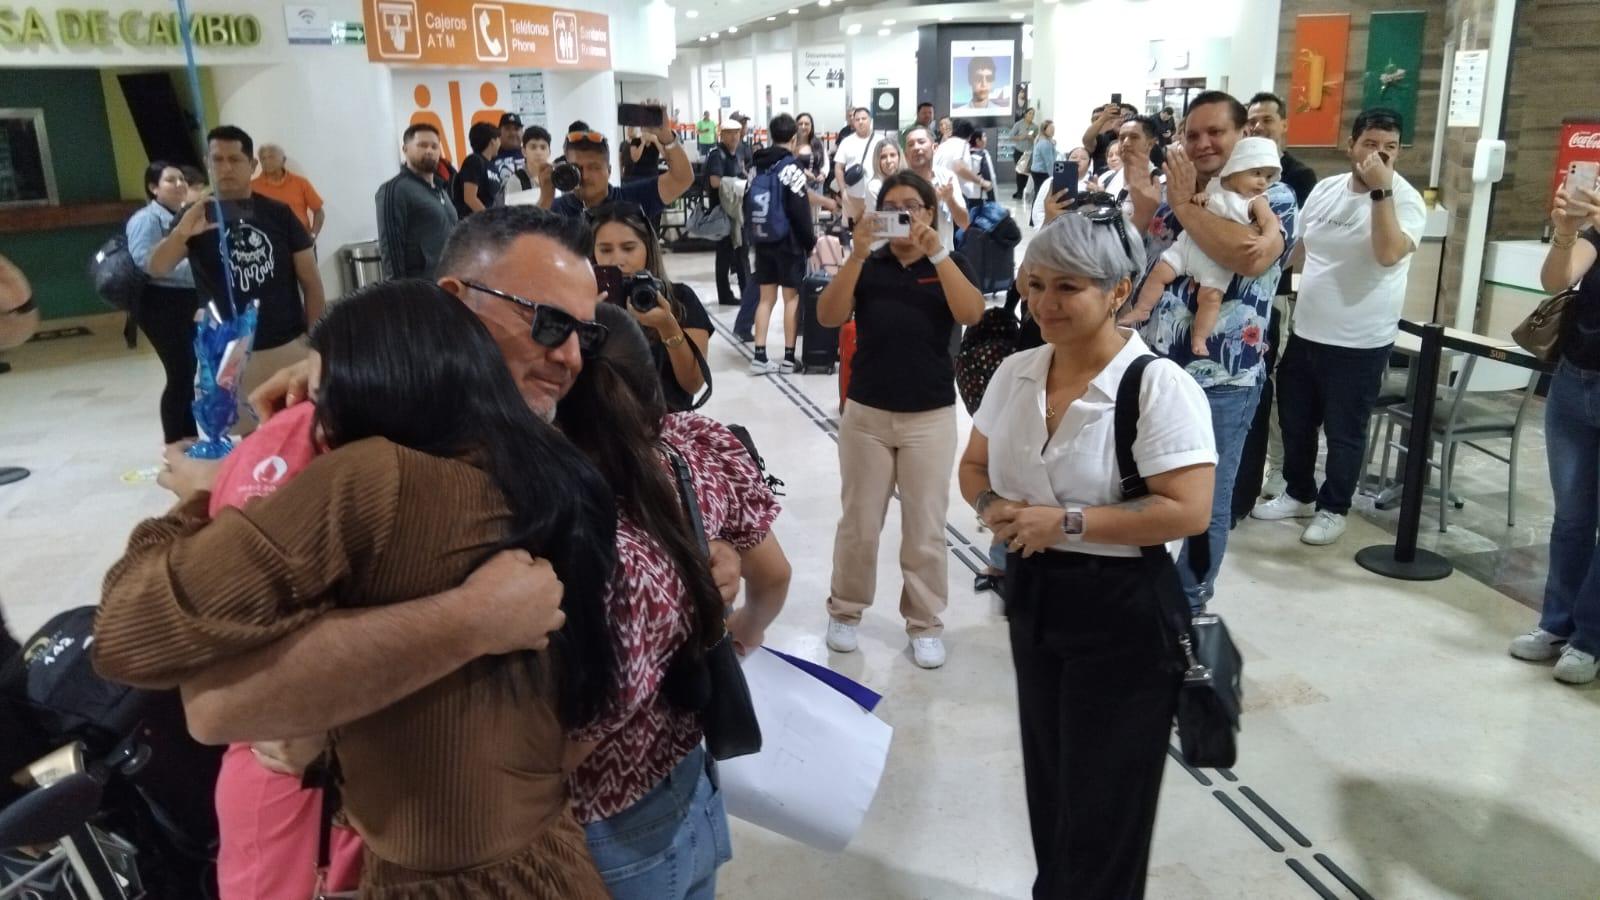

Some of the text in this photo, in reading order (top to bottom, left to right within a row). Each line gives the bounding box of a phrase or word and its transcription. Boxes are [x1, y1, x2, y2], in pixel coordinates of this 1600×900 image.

[56, 8, 110, 44] DE
[118, 9, 261, 46] CAMBIO
[425, 12, 468, 31] Cajeros
[510, 18, 549, 37] Teléfonos
[427, 34, 455, 49] ATM
[512, 38, 536, 53] Phone
